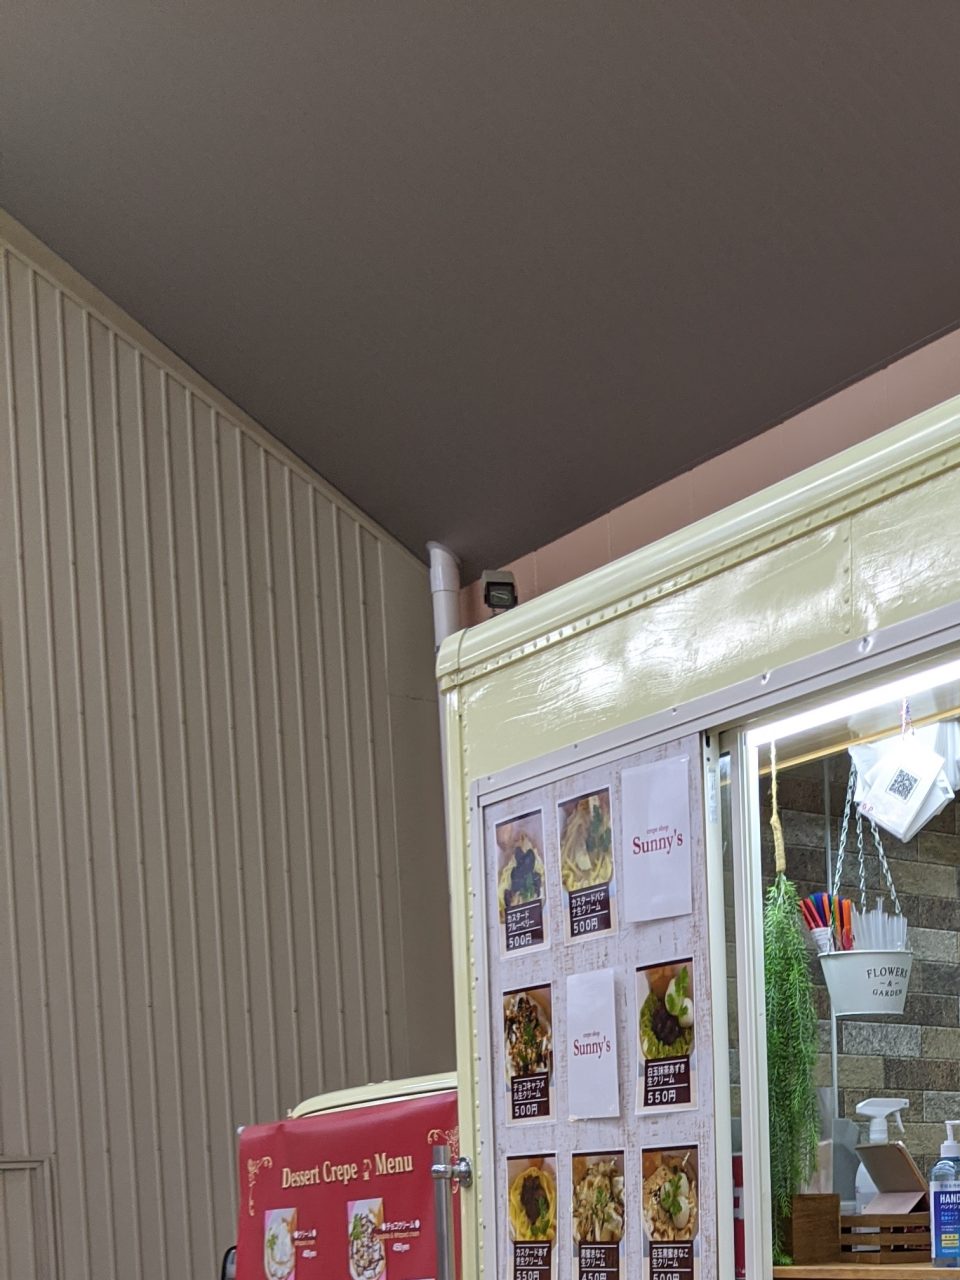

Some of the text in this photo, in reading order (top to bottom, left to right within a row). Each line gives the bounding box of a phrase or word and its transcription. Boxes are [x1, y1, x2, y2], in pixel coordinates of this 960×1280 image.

[632, 828, 684, 856] Sunny's
[573, 917, 598, 934] 500円
[508, 932, 532, 948] 500円
[866, 965, 908, 979] FLOWERS
[872, 986, 903, 998] GARDEN
[573, 1038, 612, 1059] Sunny's
[647, 1063, 686, 1077] 白玉抹茶あずき
[647, 1074, 675, 1087] 生クリーム
[647, 1089, 677, 1104] 550円
[514, 1103, 538, 1117] 500円
[281, 1151, 414, 1189] Dessert Crepe Menu
[580, 1257, 606, 1267] 生クリーム
[651, 1257, 679, 1268] 生クリーム
